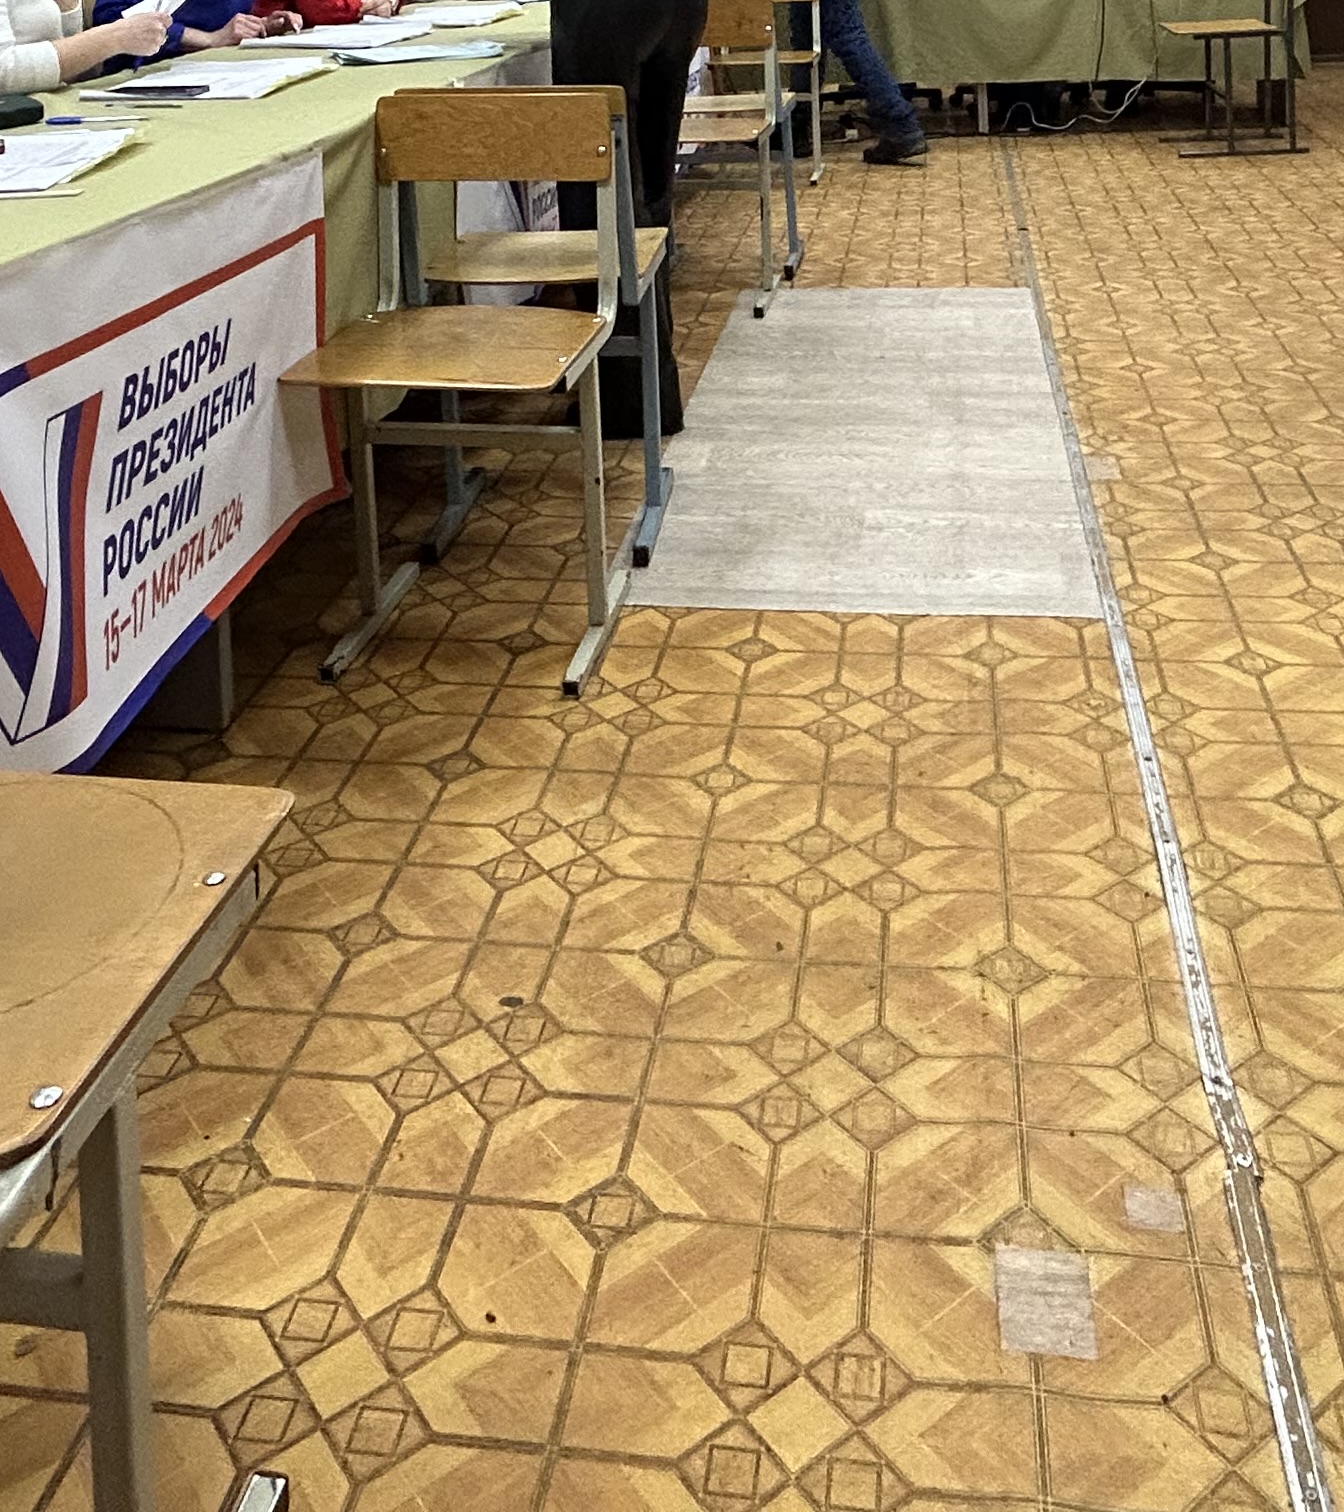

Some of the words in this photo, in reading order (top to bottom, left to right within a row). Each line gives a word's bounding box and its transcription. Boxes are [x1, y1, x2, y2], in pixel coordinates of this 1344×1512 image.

[106, 362, 256, 514] ПРЕЗИДЕНТА
[117, 318, 232, 433] ВЫБОРЫ
[103, 465, 204, 598] РОССИИ
[152, 524, 206, 619] МАРТА
[208, 492, 244, 563] 2024
